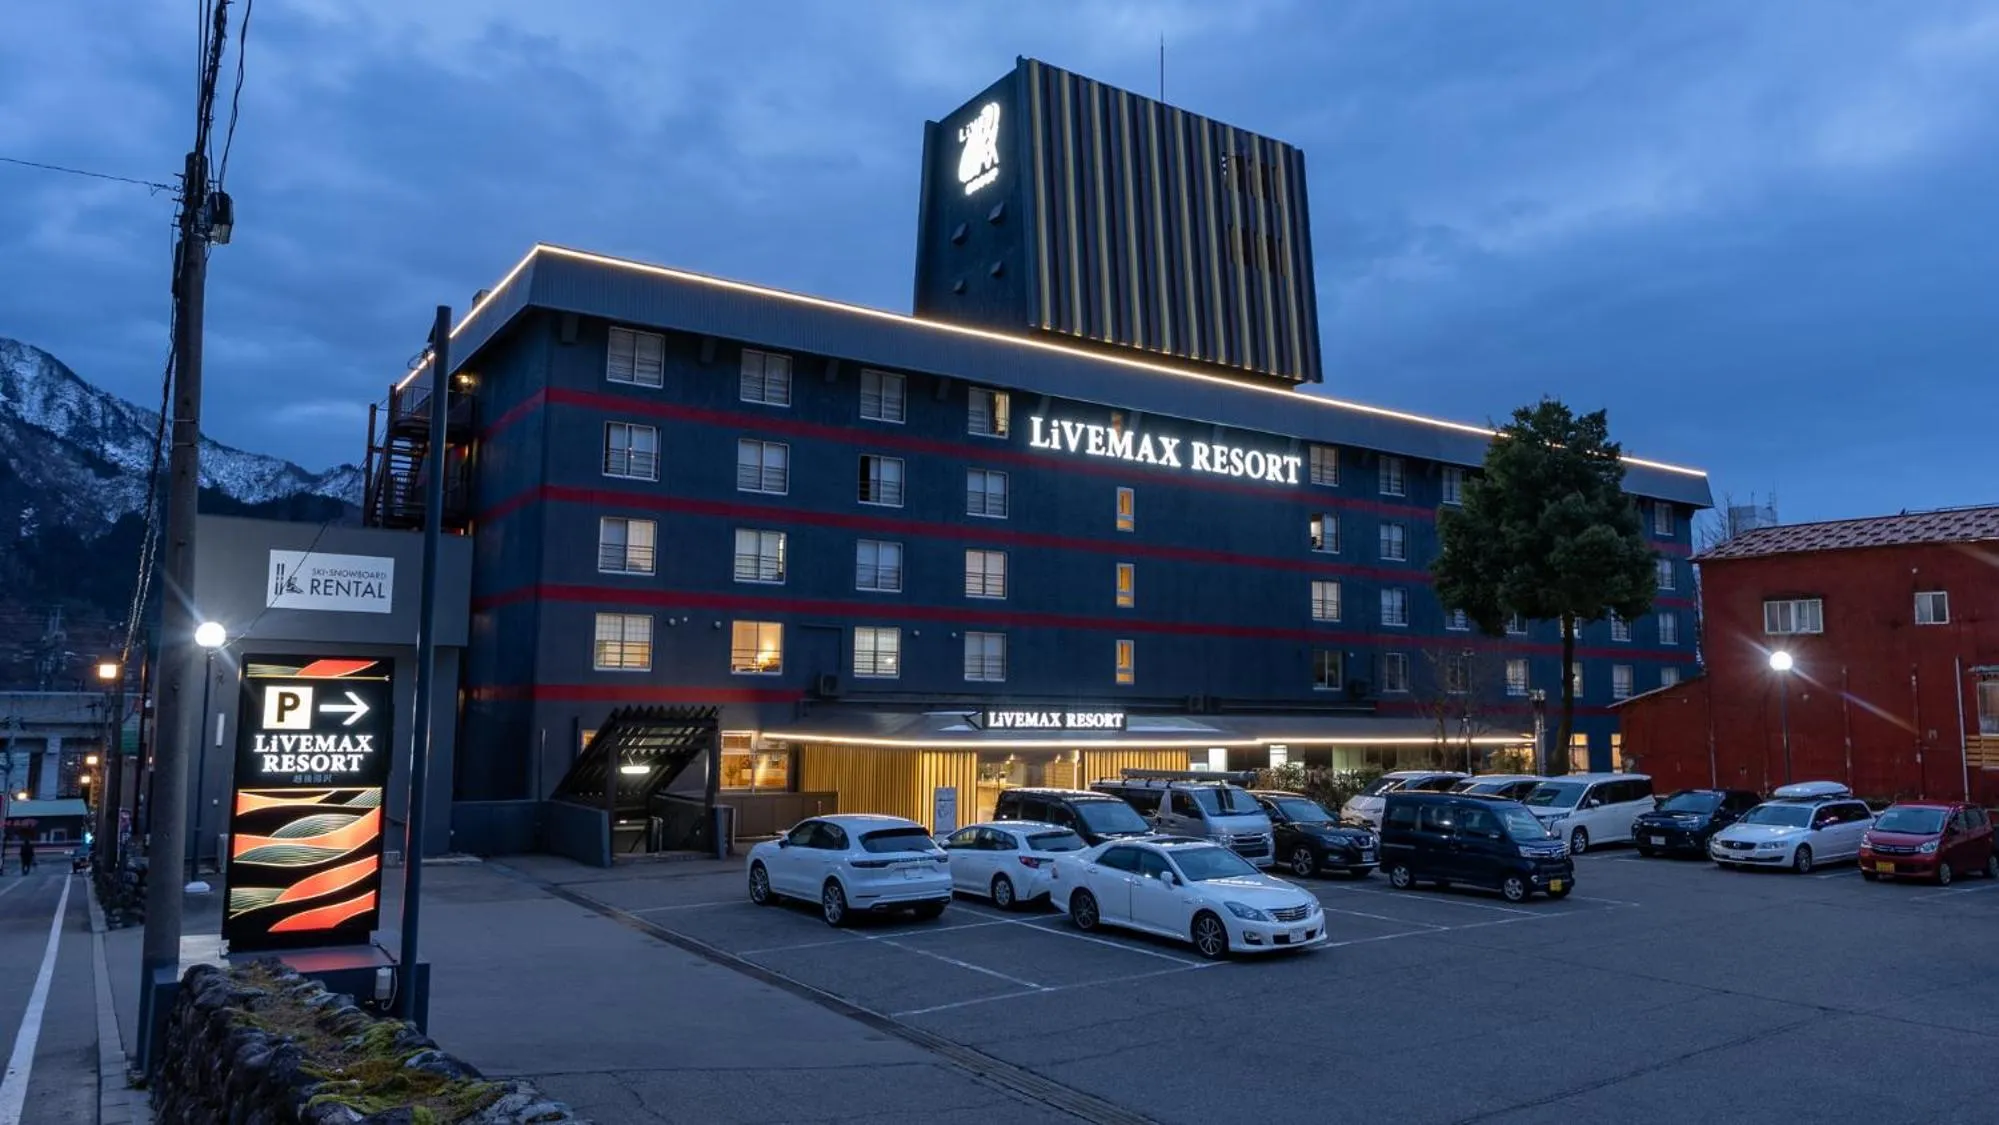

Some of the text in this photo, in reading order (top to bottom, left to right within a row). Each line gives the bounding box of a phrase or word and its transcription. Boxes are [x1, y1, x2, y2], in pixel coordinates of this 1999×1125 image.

[1029, 416, 1301, 484] LiVEMAX RESORT
[310, 578, 386, 599] RENTAL
[276, 692, 301, 723] P
[989, 711, 1124, 728] LiVEMAX RESORT
[253, 734, 373, 753] LiVEMAX
[262, 754, 364, 773] RESORT
